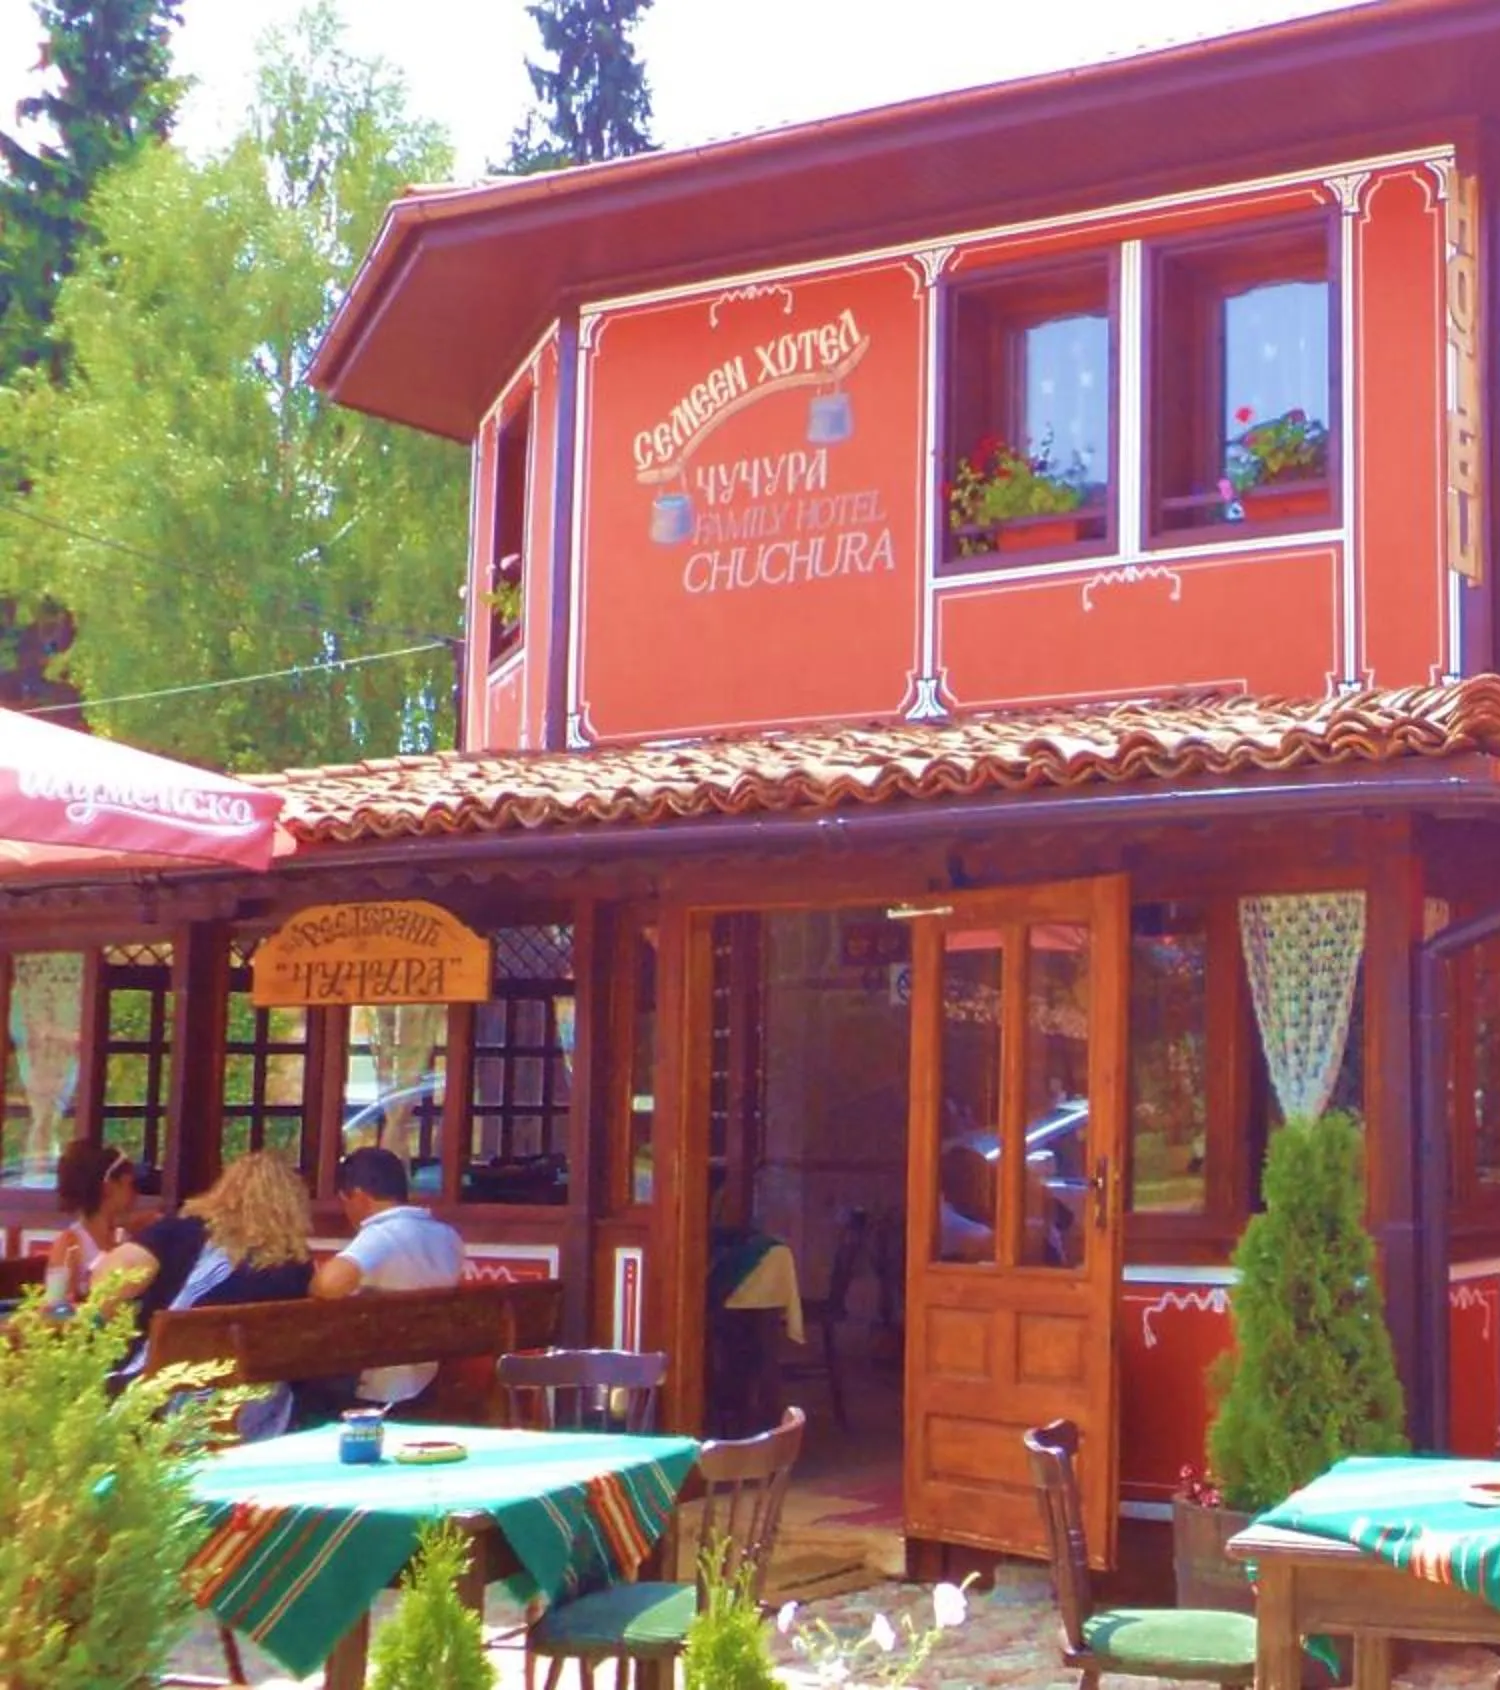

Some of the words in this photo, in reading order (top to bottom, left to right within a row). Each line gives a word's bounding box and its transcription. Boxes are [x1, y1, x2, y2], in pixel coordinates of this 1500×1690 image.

[632, 355, 749, 471] СЕМЕЕН
[756, 308, 862, 382] ХОТЕЛ
[696, 448, 828, 505] ЧУЧУРА
[692, 501, 791, 545] FAMILY
[796, 488, 887, 531] HOTEL
[682, 527, 896, 593] CHUCHURA
